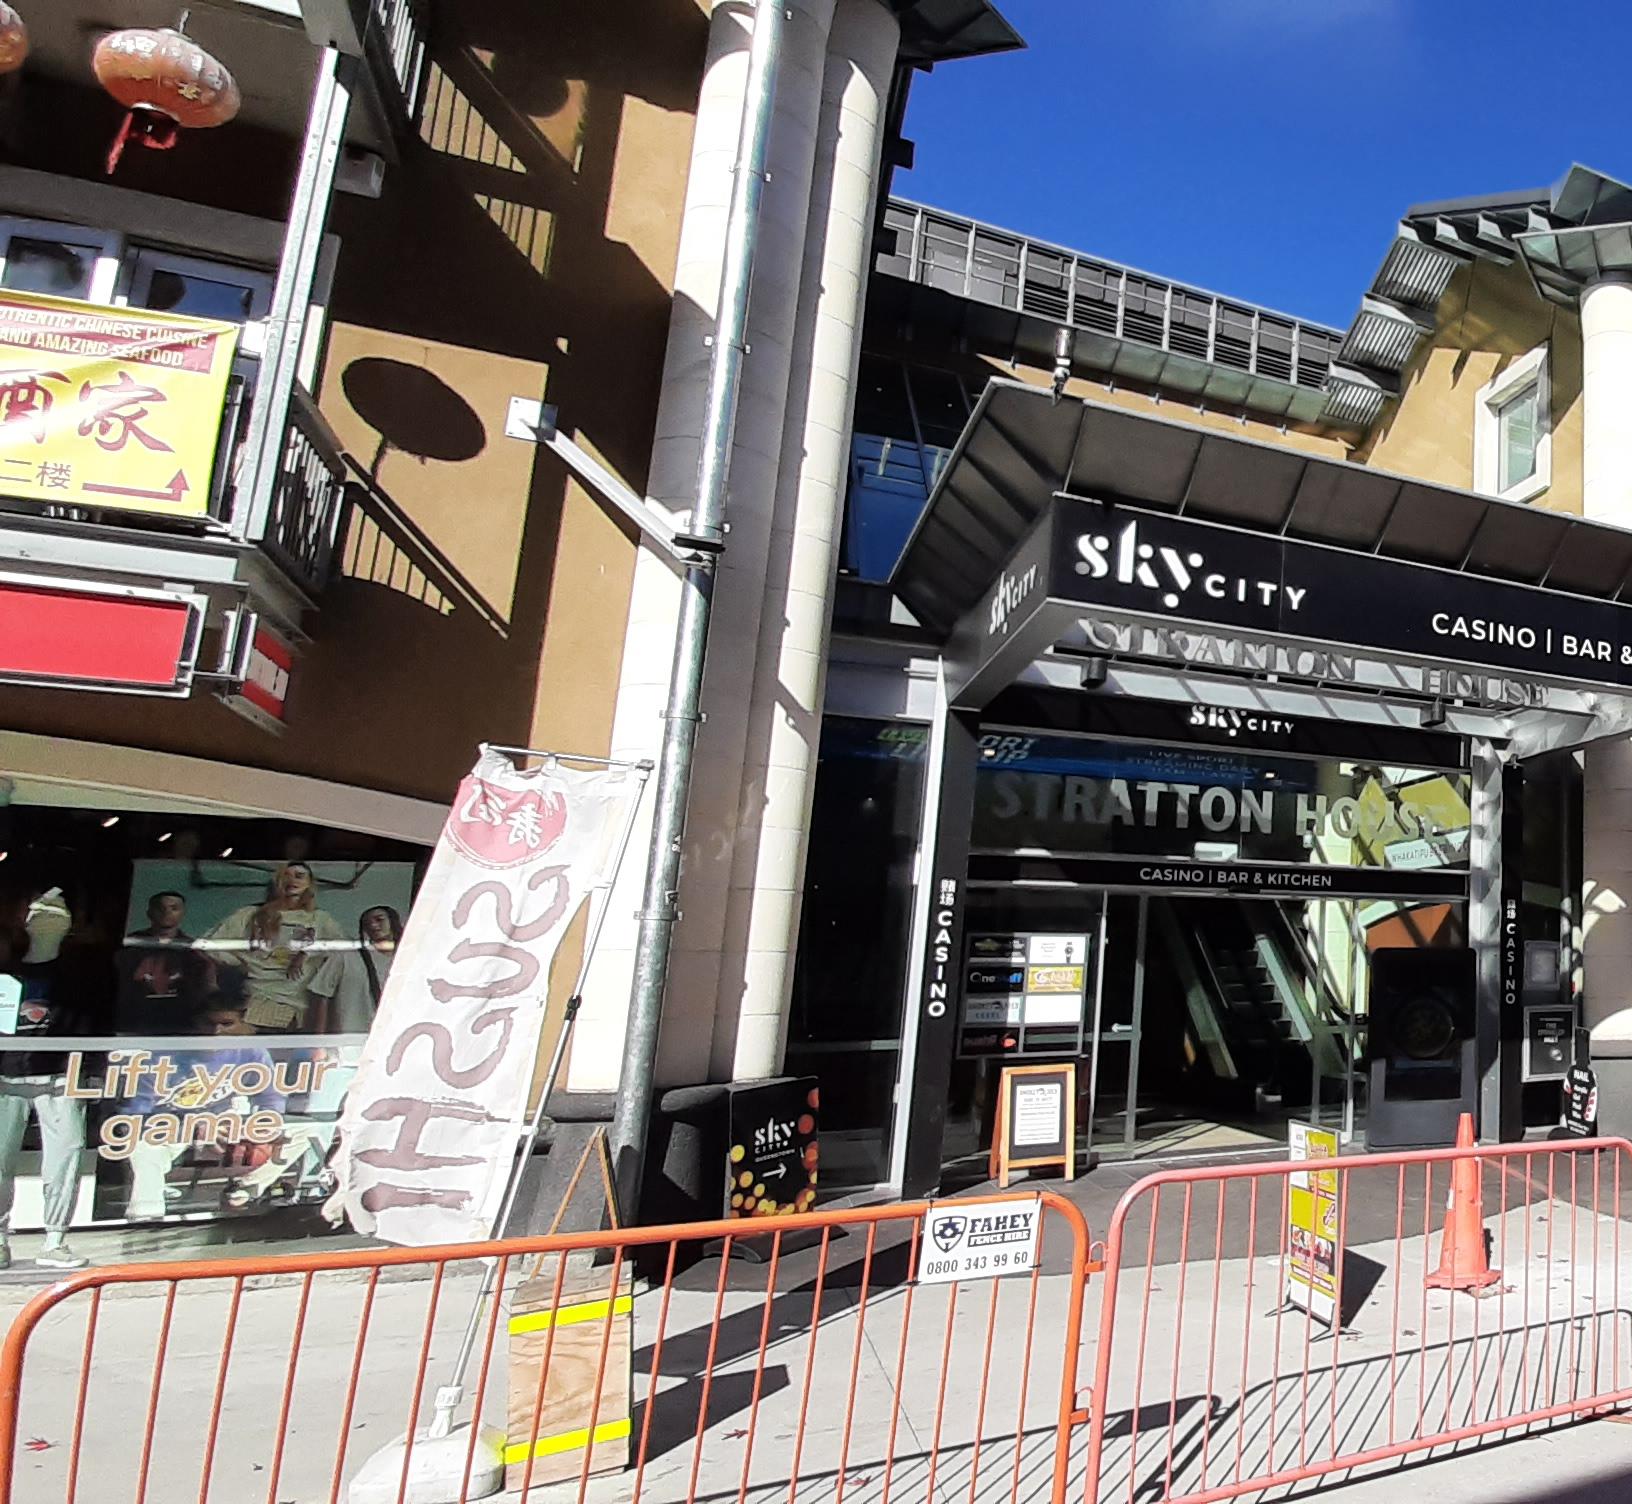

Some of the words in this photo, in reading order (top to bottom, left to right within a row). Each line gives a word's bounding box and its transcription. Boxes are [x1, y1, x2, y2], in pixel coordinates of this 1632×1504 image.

[75, 316, 144, 338] CHINESE
[0, 327, 32, 345] AND
[34, 332, 109, 355] AMAZING
[110, 342, 184, 366] SEAFOOD
[0, 459, 72, 490] 二楼
[1432, 612, 1536, 649] CASINO
[1563, 635, 1612, 662] BAR
[992, 772, 1274, 834] STRATTON
[1296, 793, 1450, 841] HOUSE
[1139, 868, 1204, 883] CASINO
[1217, 871, 1249, 884] BAR
[1253, 872, 1263, 885] &
[1268, 873, 1332, 887] KITCHEN
[928, 910, 954, 1017] CASINO
[969, 972, 1023, 984] Oneff
[1505, 923, 1516, 1005] CASINO
[63, 1049, 178, 1099] Lift
[192, 1061, 338, 1109] your
[98, 1109, 284, 1162] game
[969, 1213, 1033, 1233] FAHEY
[970, 1234, 1003, 1246] FENCE
[1004, 1230, 1030, 1242] HIRE
[927, 1259, 958, 1275] 0800
[964, 1256, 988, 1271] 343
[993, 1253, 1008, 1267] 99
[1014, 1251, 1028, 1264] 60
